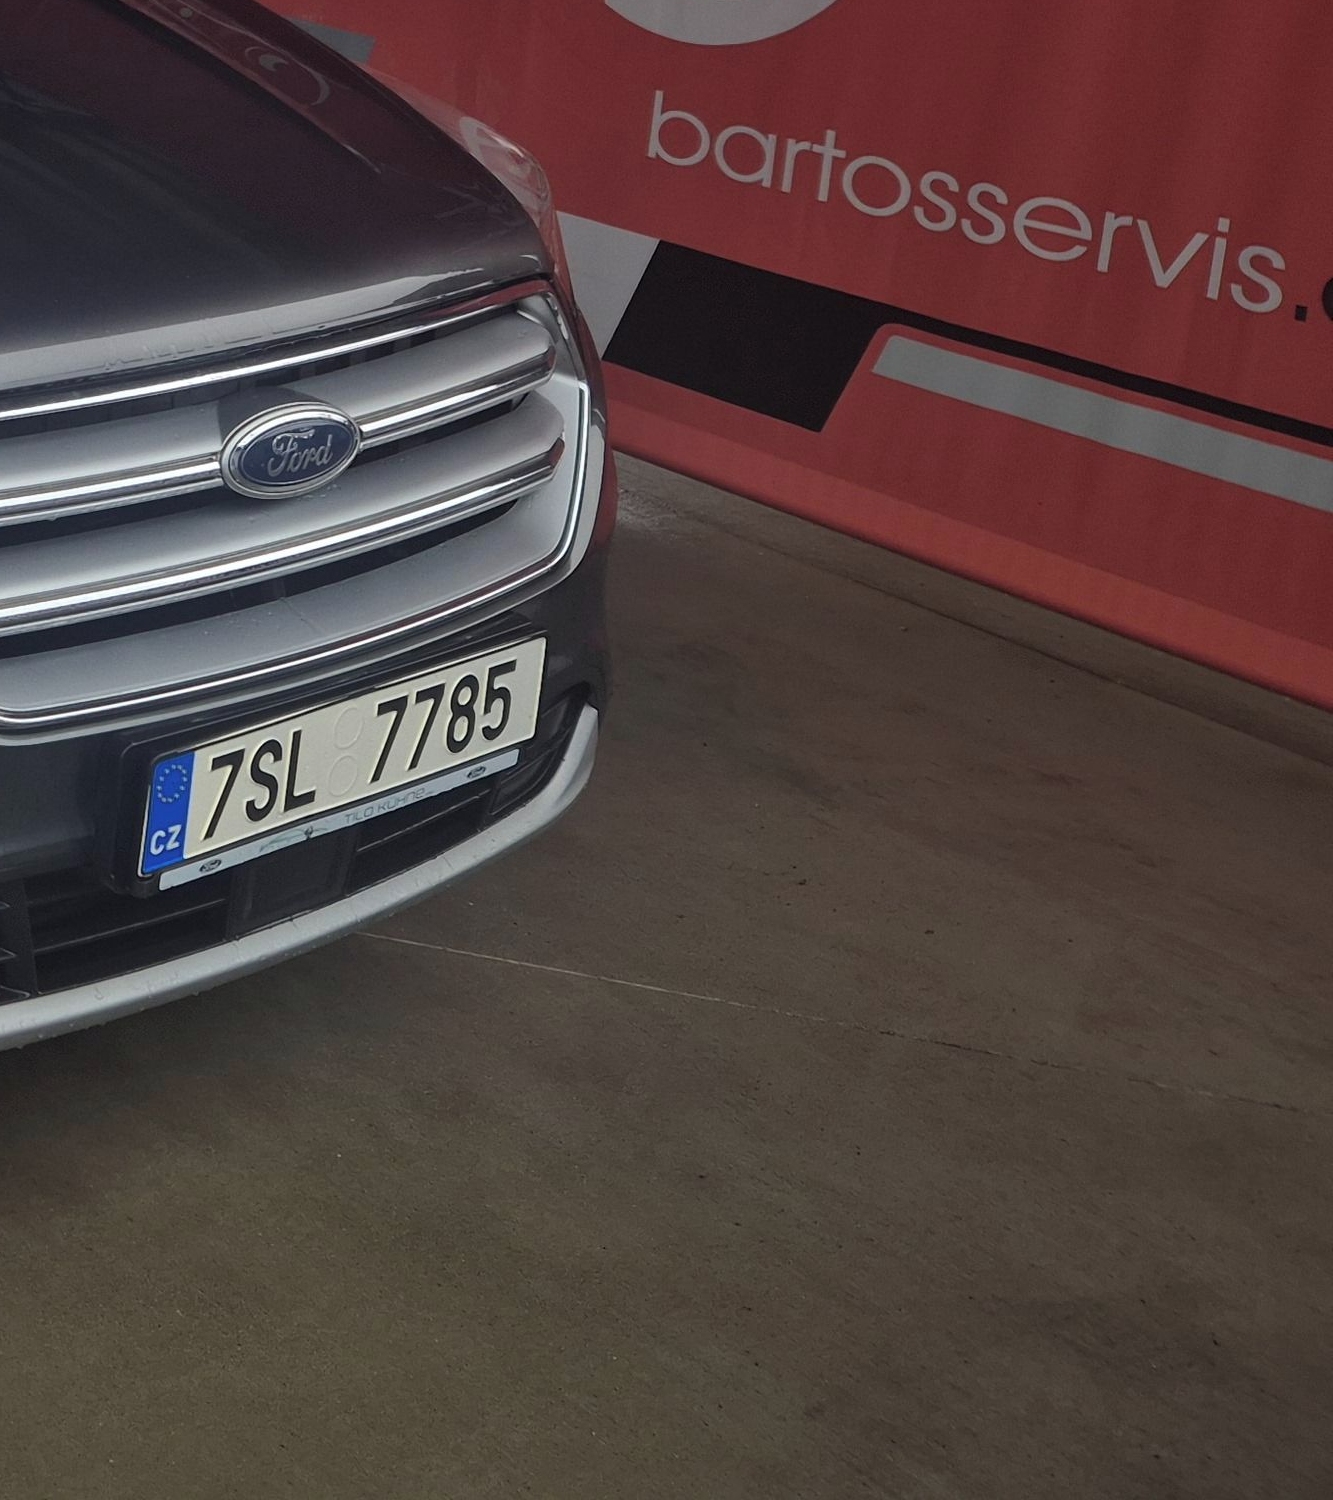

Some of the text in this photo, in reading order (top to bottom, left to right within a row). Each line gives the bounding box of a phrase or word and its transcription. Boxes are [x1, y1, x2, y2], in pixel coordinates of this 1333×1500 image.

[647, 89, 1333, 324] bartosservis.
[268, 427, 333, 477] Ford
[203, 658, 518, 841] 7SL 7785
[149, 823, 181, 857] CZ
